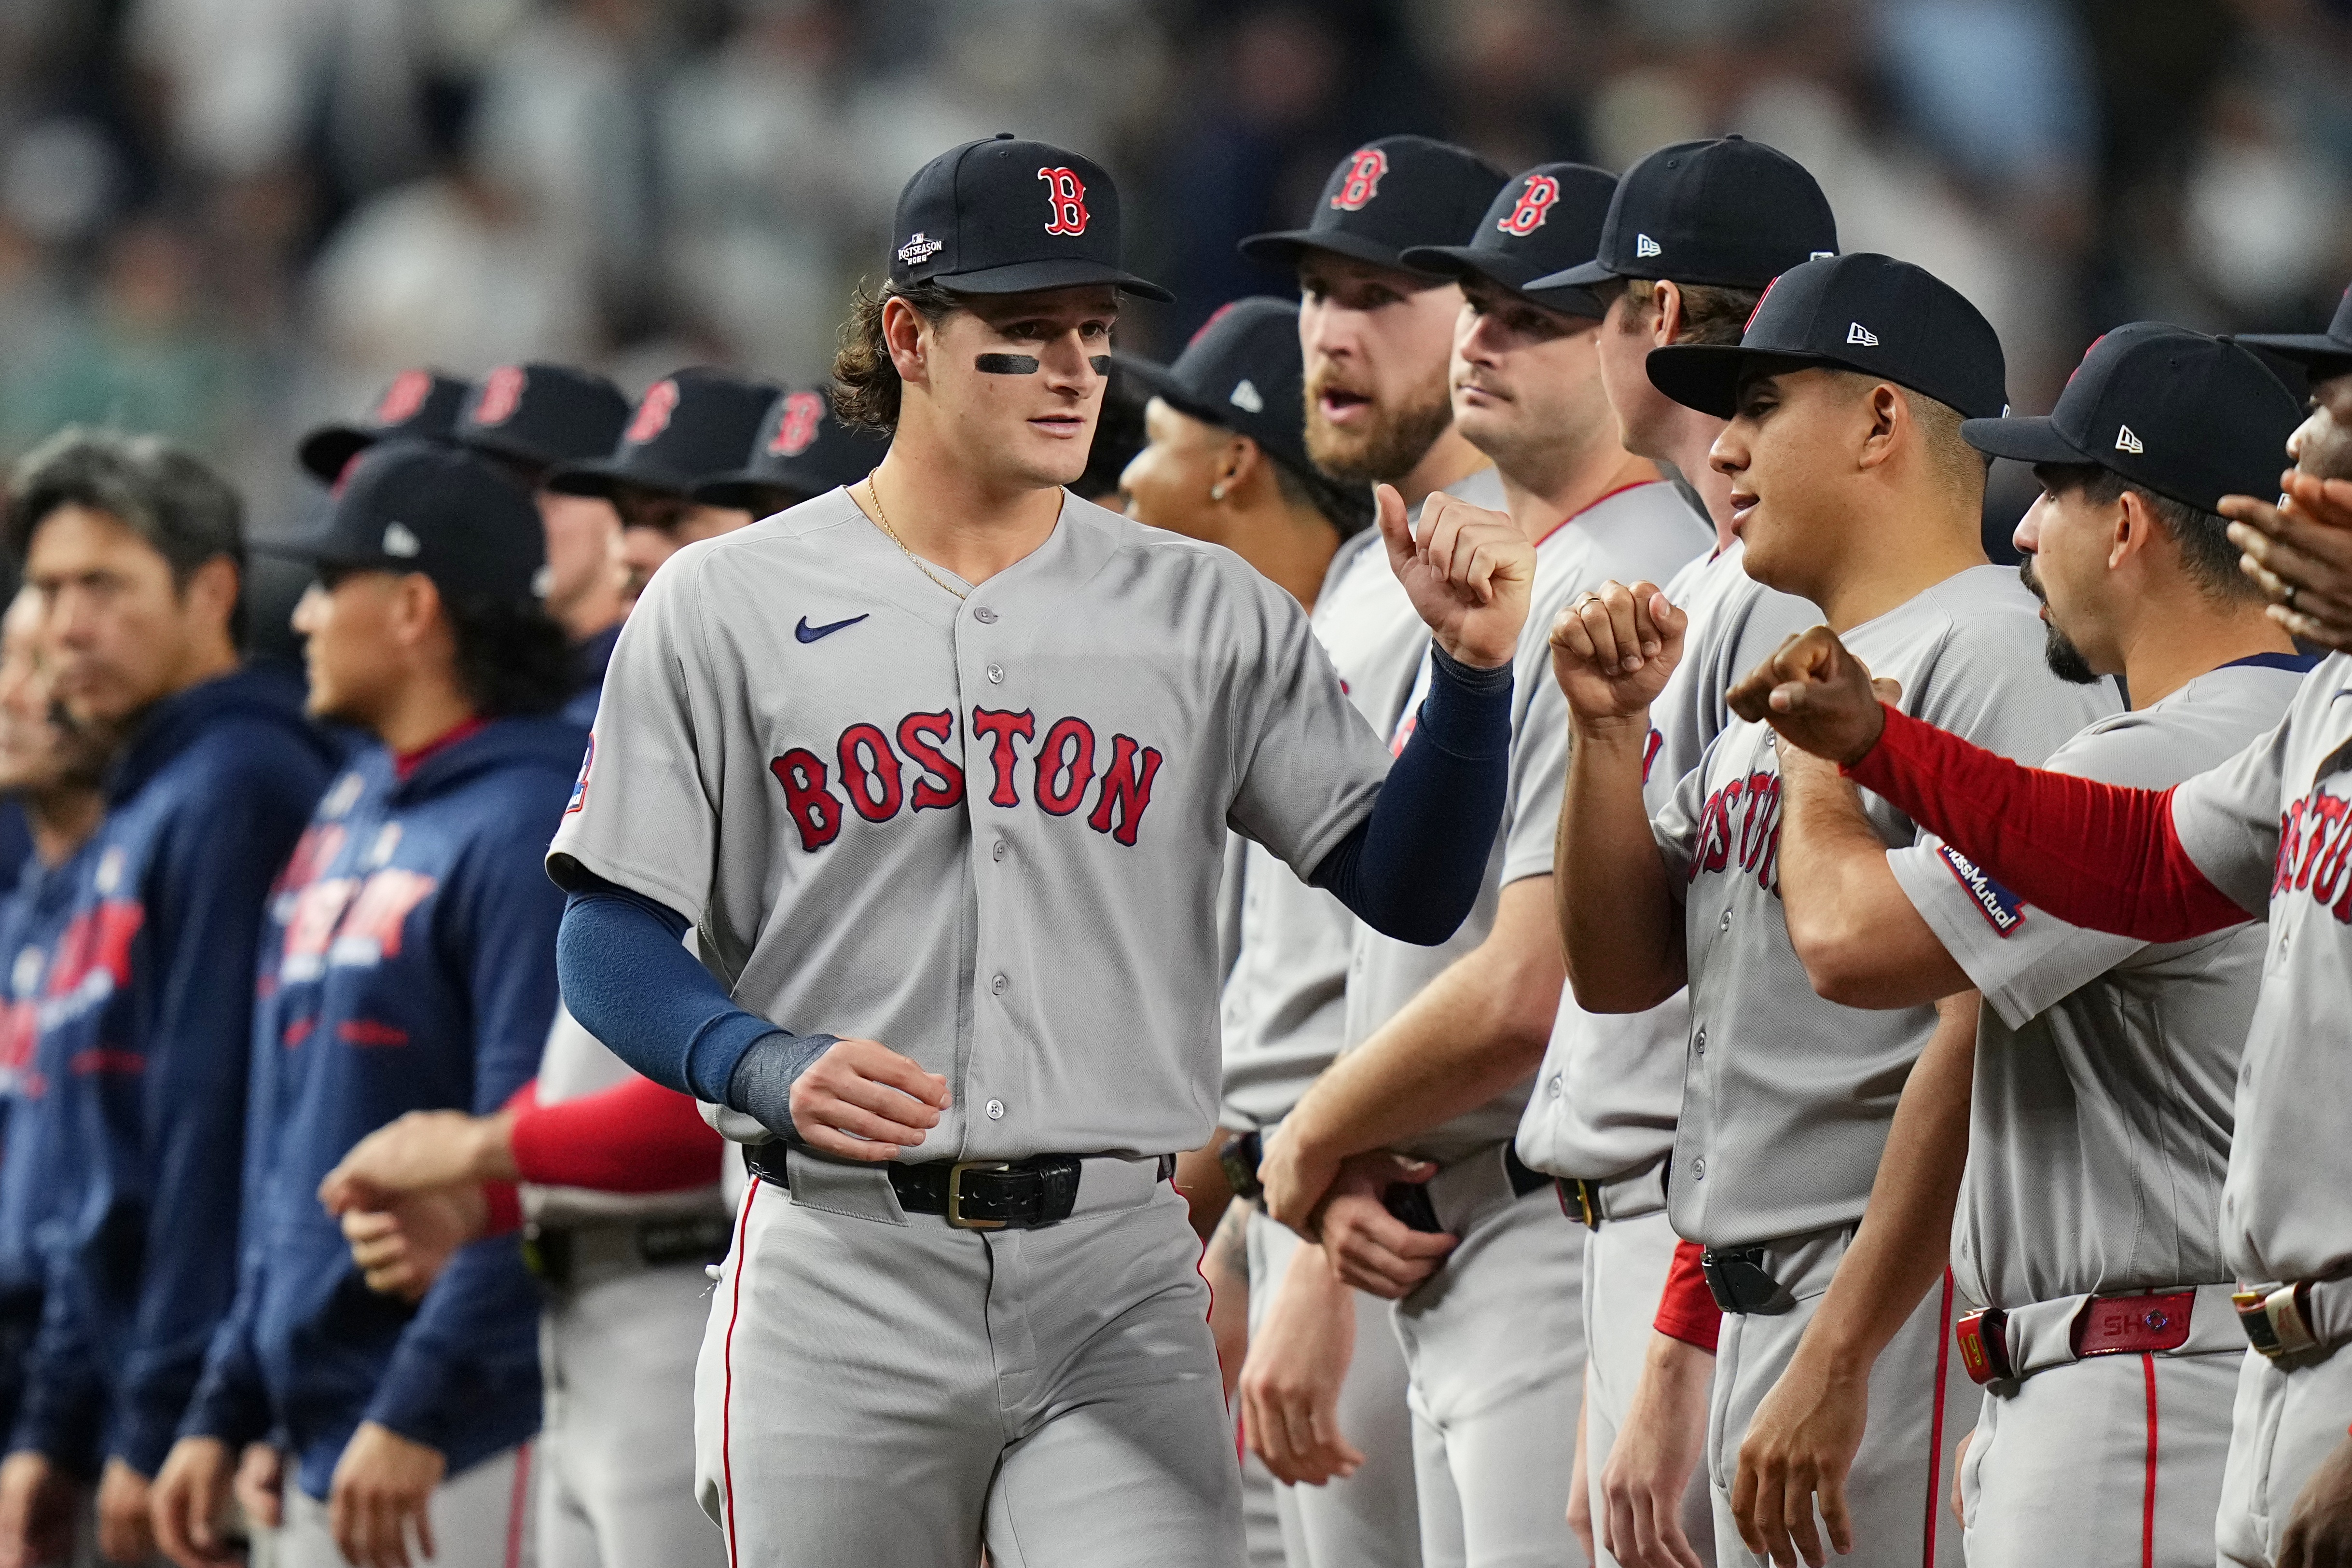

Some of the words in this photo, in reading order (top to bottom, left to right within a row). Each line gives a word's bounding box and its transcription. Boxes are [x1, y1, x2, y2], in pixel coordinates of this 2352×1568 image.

[1038, 167, 1091, 236] B
[1330, 149, 1389, 211] B
[1497, 174, 1560, 237] B
[898, 240, 942, 261] POSTSEASON
[770, 705, 1163, 853] BOSTON
[1961, 1333, 1982, 1369] 19
